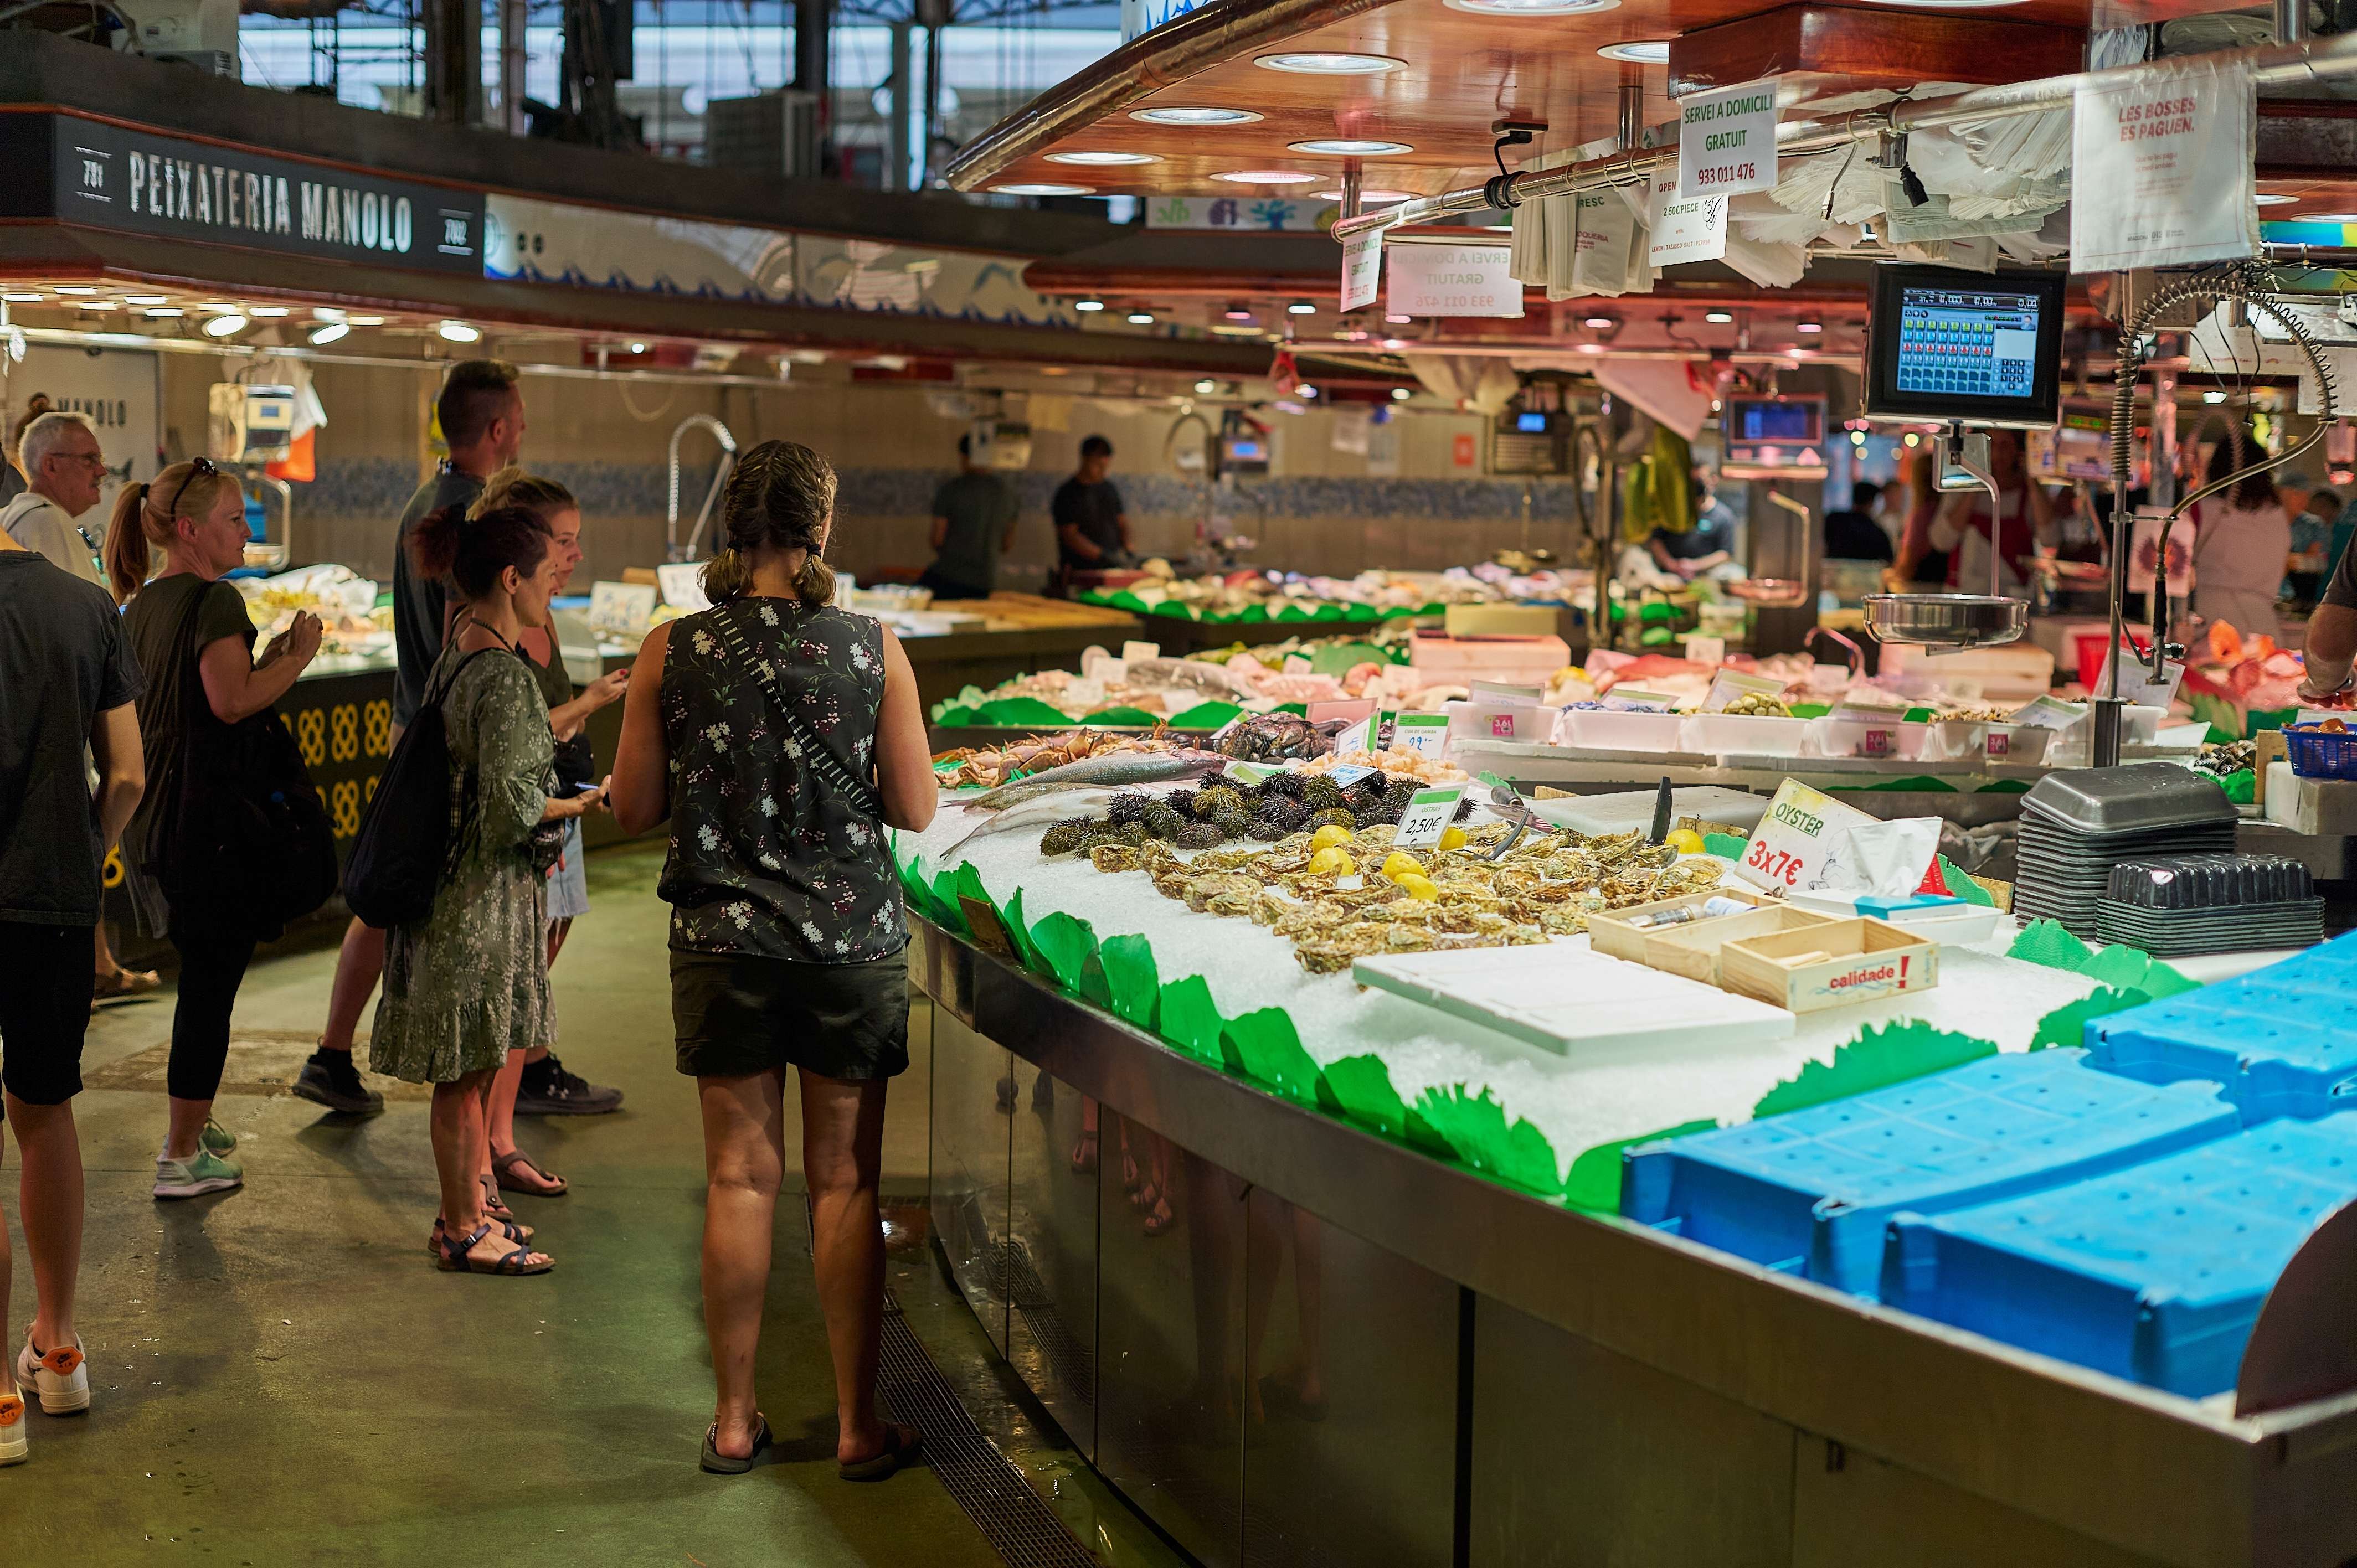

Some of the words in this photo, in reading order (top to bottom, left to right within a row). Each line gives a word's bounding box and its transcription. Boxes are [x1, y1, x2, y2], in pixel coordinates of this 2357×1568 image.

[1685, 104, 1715, 124] SERVEI
[1717, 102, 1723, 118] A
[1726, 94, 1772, 117] DOMICILI
[2119, 105, 2141, 123] LES
[2145, 97, 2196, 120] BOSSES
[1706, 130, 1747, 151] GRATUIT
[2120, 125, 2136, 142] ES
[2139, 117, 2194, 139] PAGUEN.
[1699, 168, 1715, 185] 933
[1718, 165, 1734, 183] 011
[1737, 163, 1754, 180] 476
[1659, 181, 1676, 193] OPEN
[130, 151, 291, 236] PEIXATERIA
[301, 182, 412, 253] MANOLO
[1405, 817, 1442, 836] 2,50€
[1776, 803, 1824, 837] OYSTER
[1748, 840, 1803, 886] 3x7€
